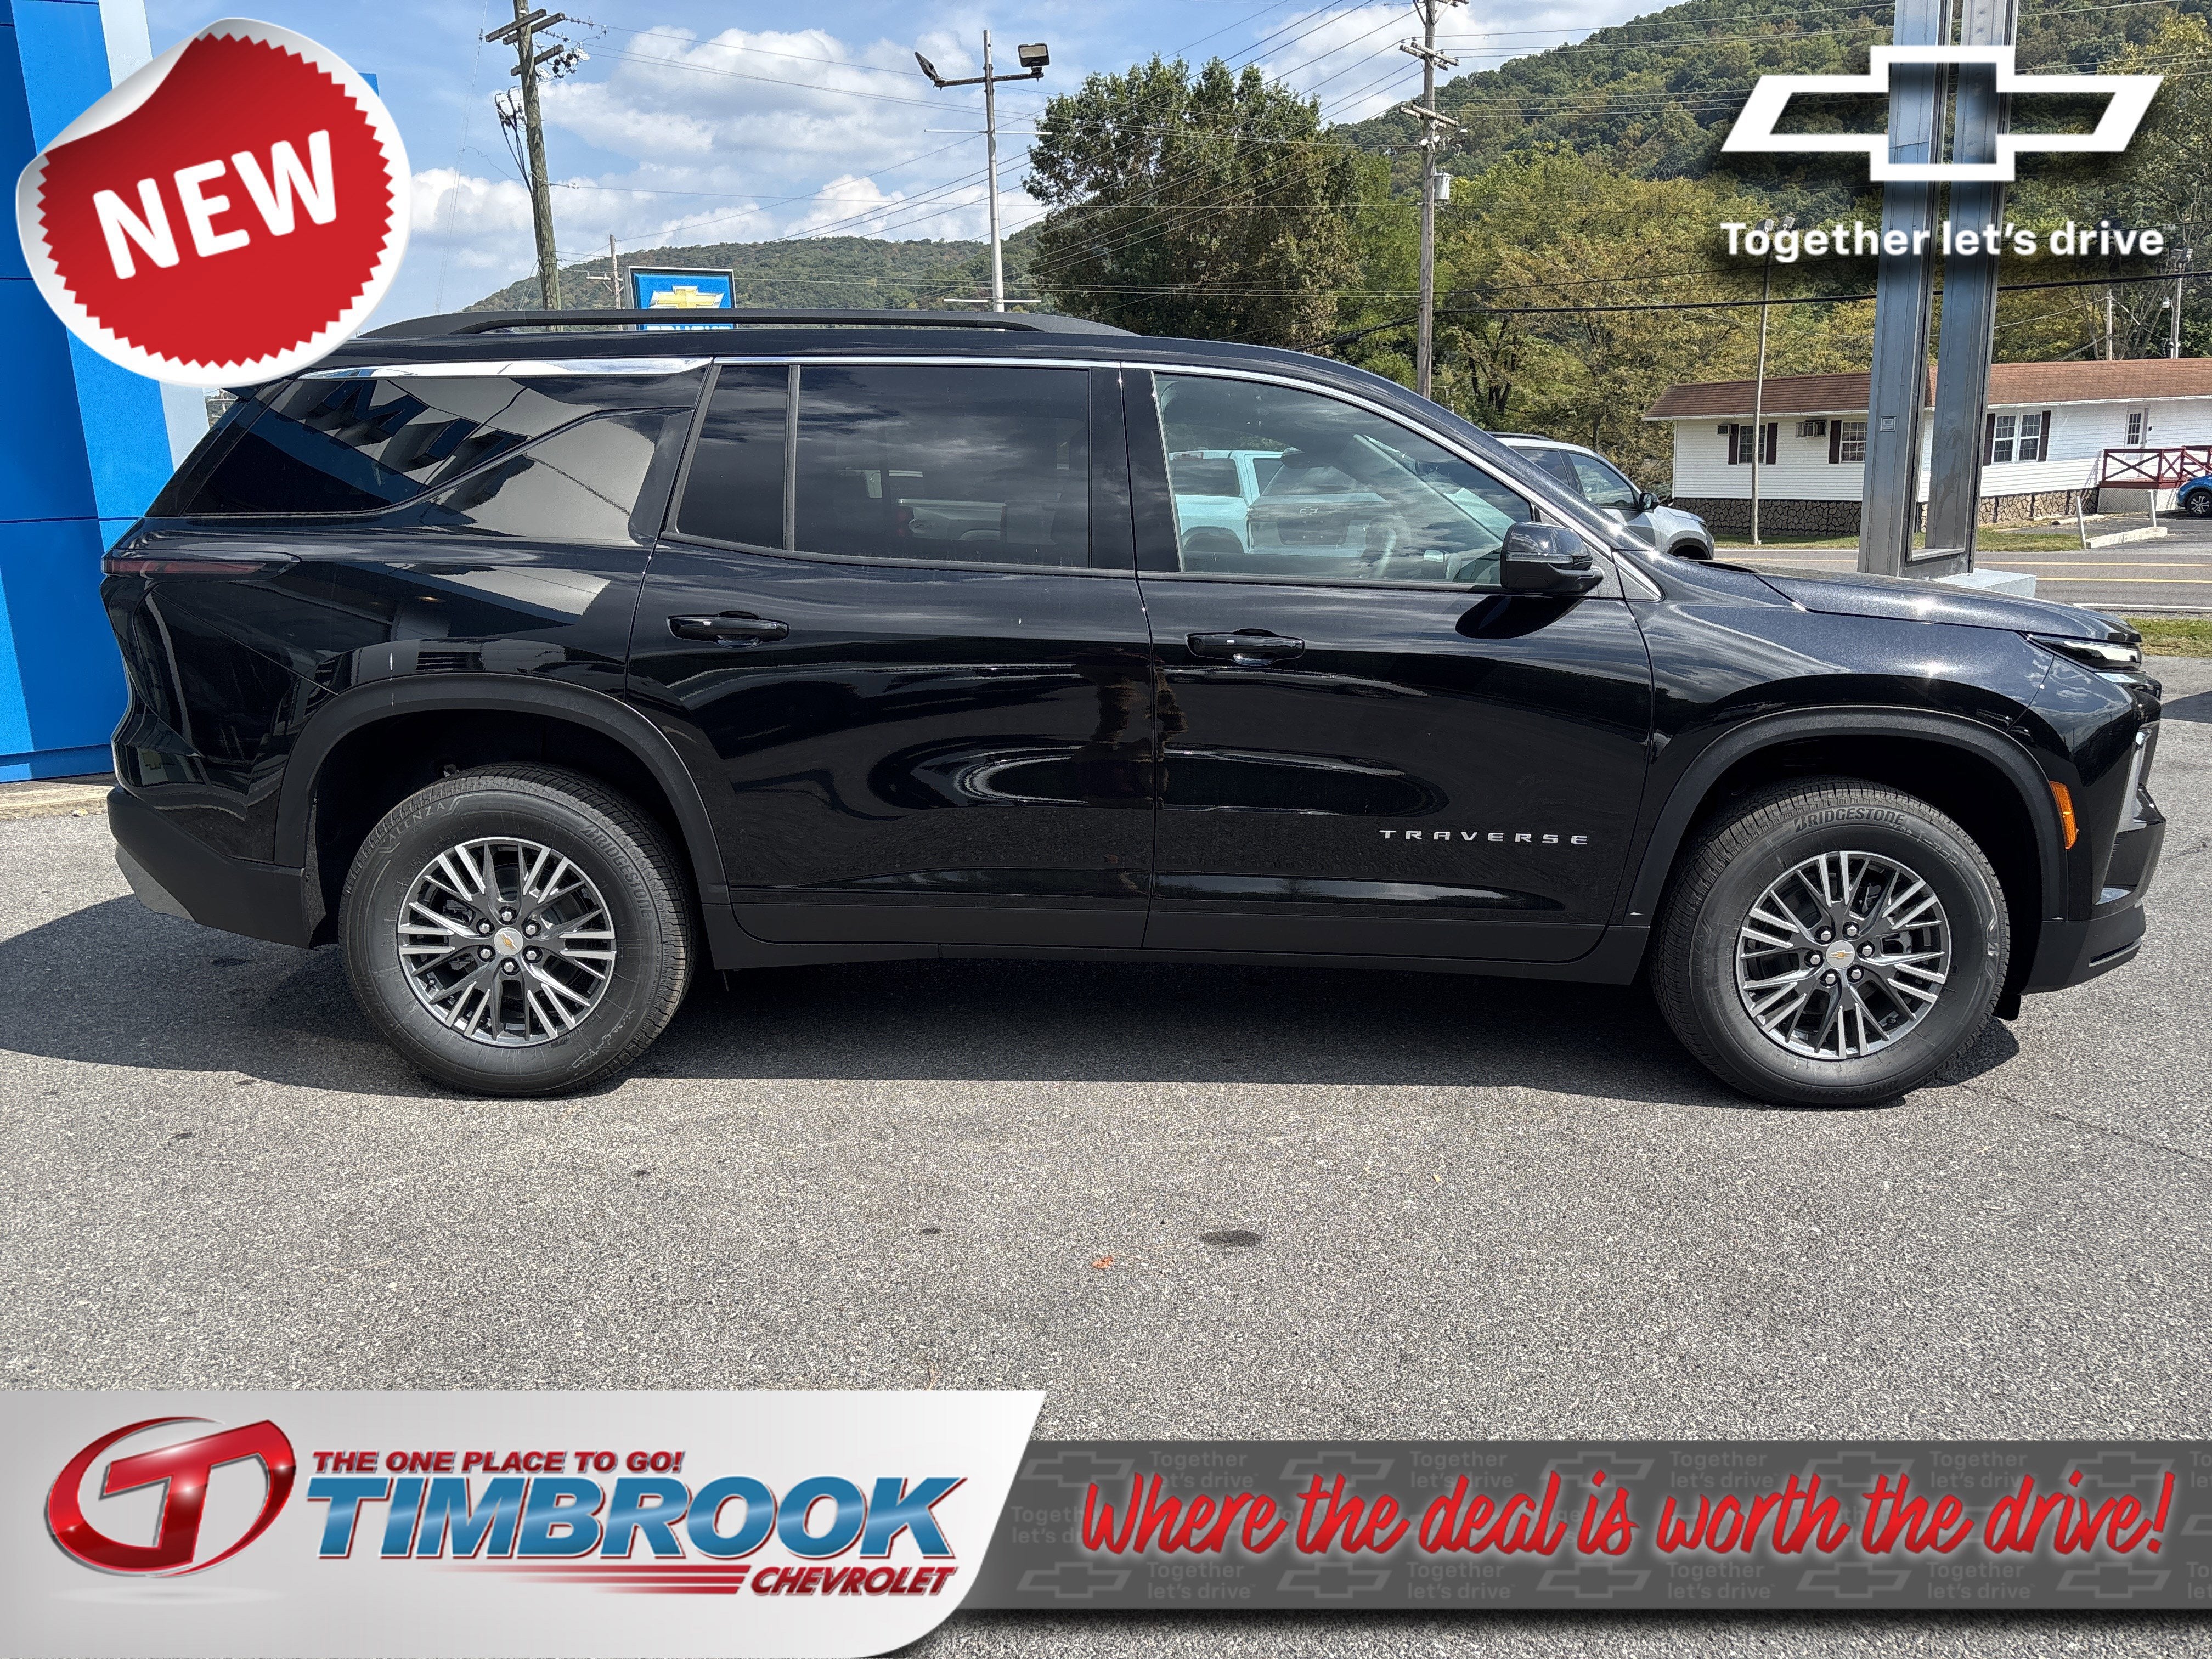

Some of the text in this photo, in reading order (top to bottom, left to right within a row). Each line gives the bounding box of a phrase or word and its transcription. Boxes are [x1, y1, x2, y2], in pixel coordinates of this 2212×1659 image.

[388, 802, 445, 843] ALENZA
[1794, 807, 1905, 833] BRIDGESTONE
[1379, 830, 1588, 845] TRAVERSE
[579, 824, 654, 918] BRIDGESTONE
